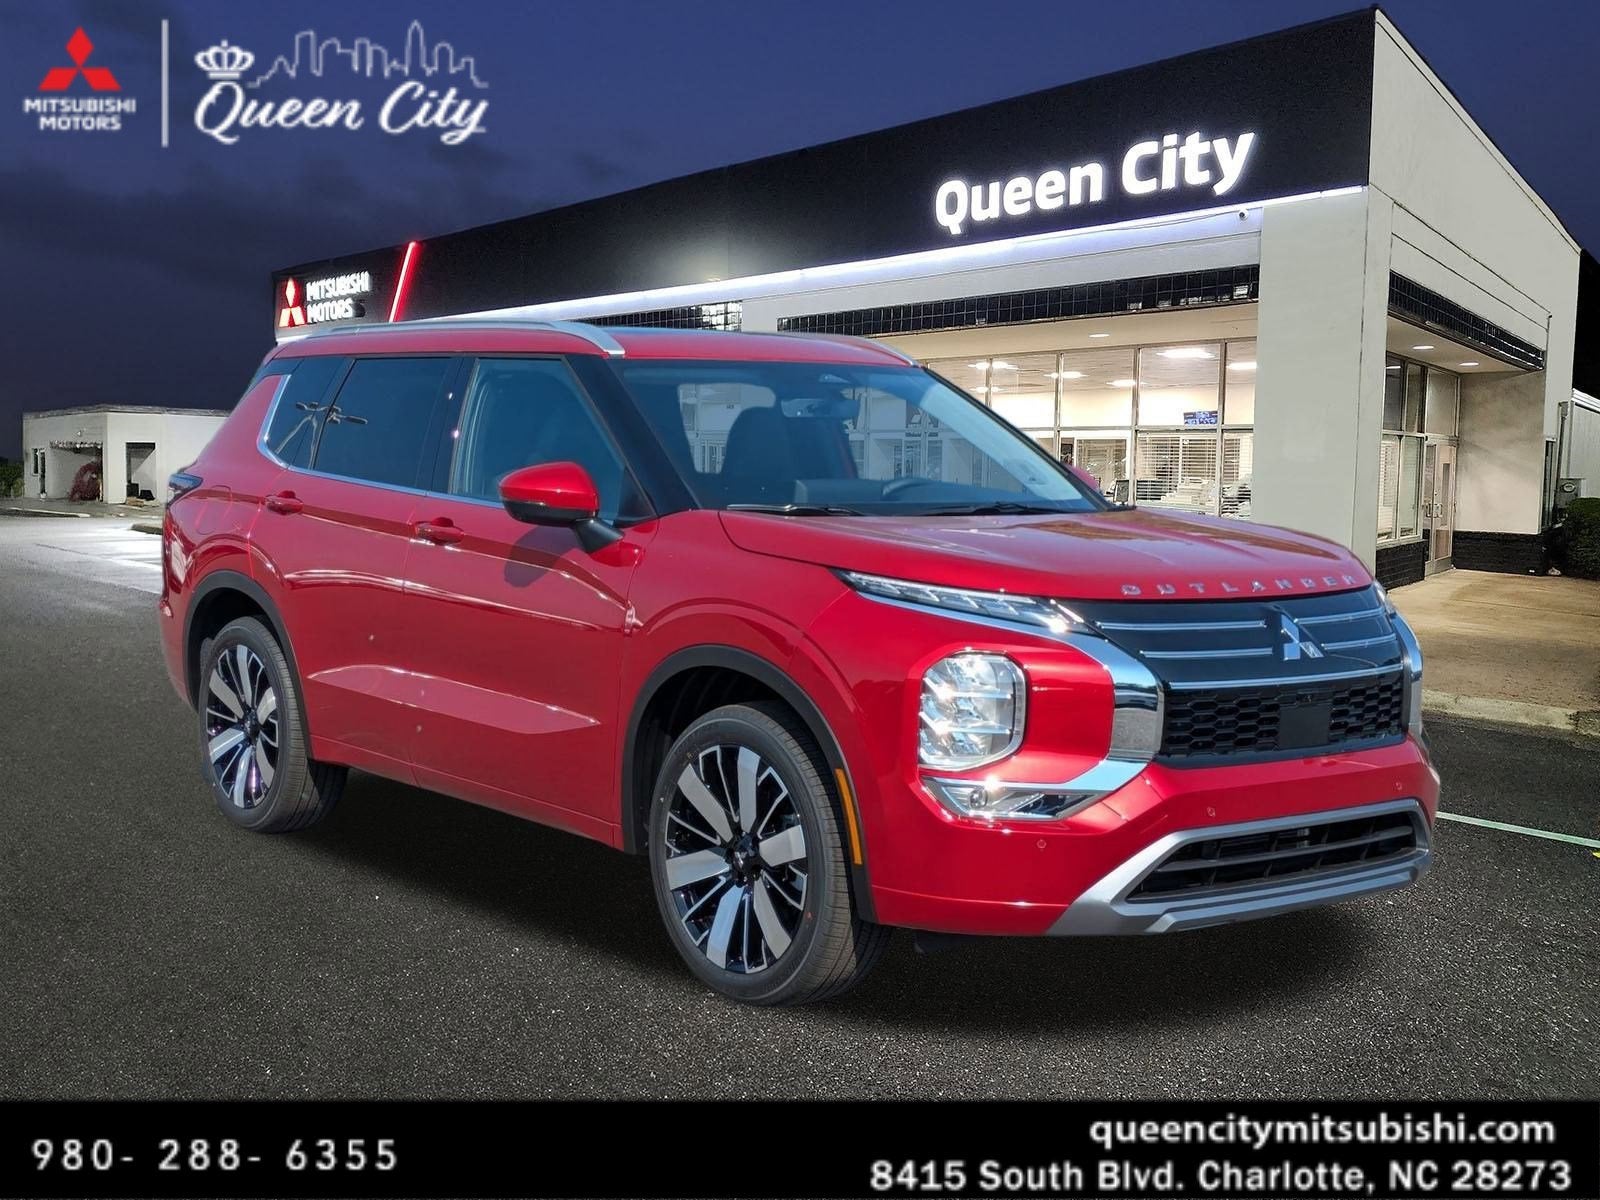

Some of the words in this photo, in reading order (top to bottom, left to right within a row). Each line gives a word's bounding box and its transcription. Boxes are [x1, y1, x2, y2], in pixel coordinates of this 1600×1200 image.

[935, 161, 1104, 235] Queen
[1121, 131, 1256, 195] City
[306, 270, 369, 302] MITSUBISHI
[307, 297, 354, 324] MOTORS
[1120, 574, 1357, 596] OUTLANDER
